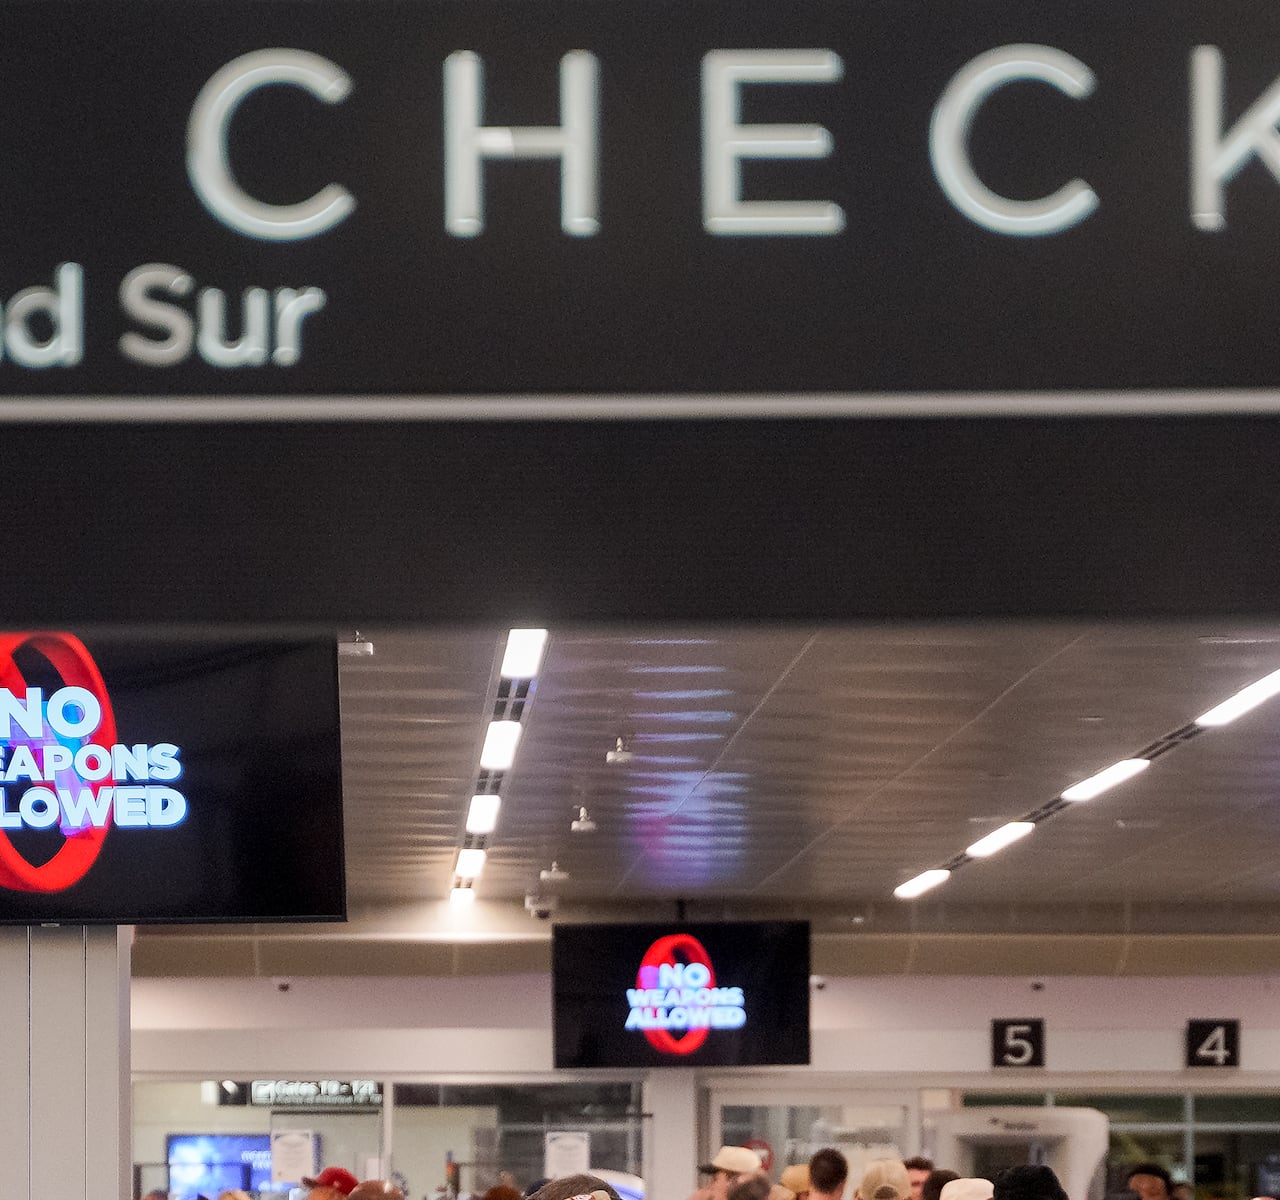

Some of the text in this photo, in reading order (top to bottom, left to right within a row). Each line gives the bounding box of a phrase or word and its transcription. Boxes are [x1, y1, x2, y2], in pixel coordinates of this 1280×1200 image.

[120, 260, 326, 370] Sur
[658, 963, 710, 988] NO
[626, 987, 745, 1007] WEAPONS
[624, 1006, 747, 1029] ALLOWED
[1003, 1024, 1033, 1065] 5
[1197, 1025, 1229, 1066] 4
